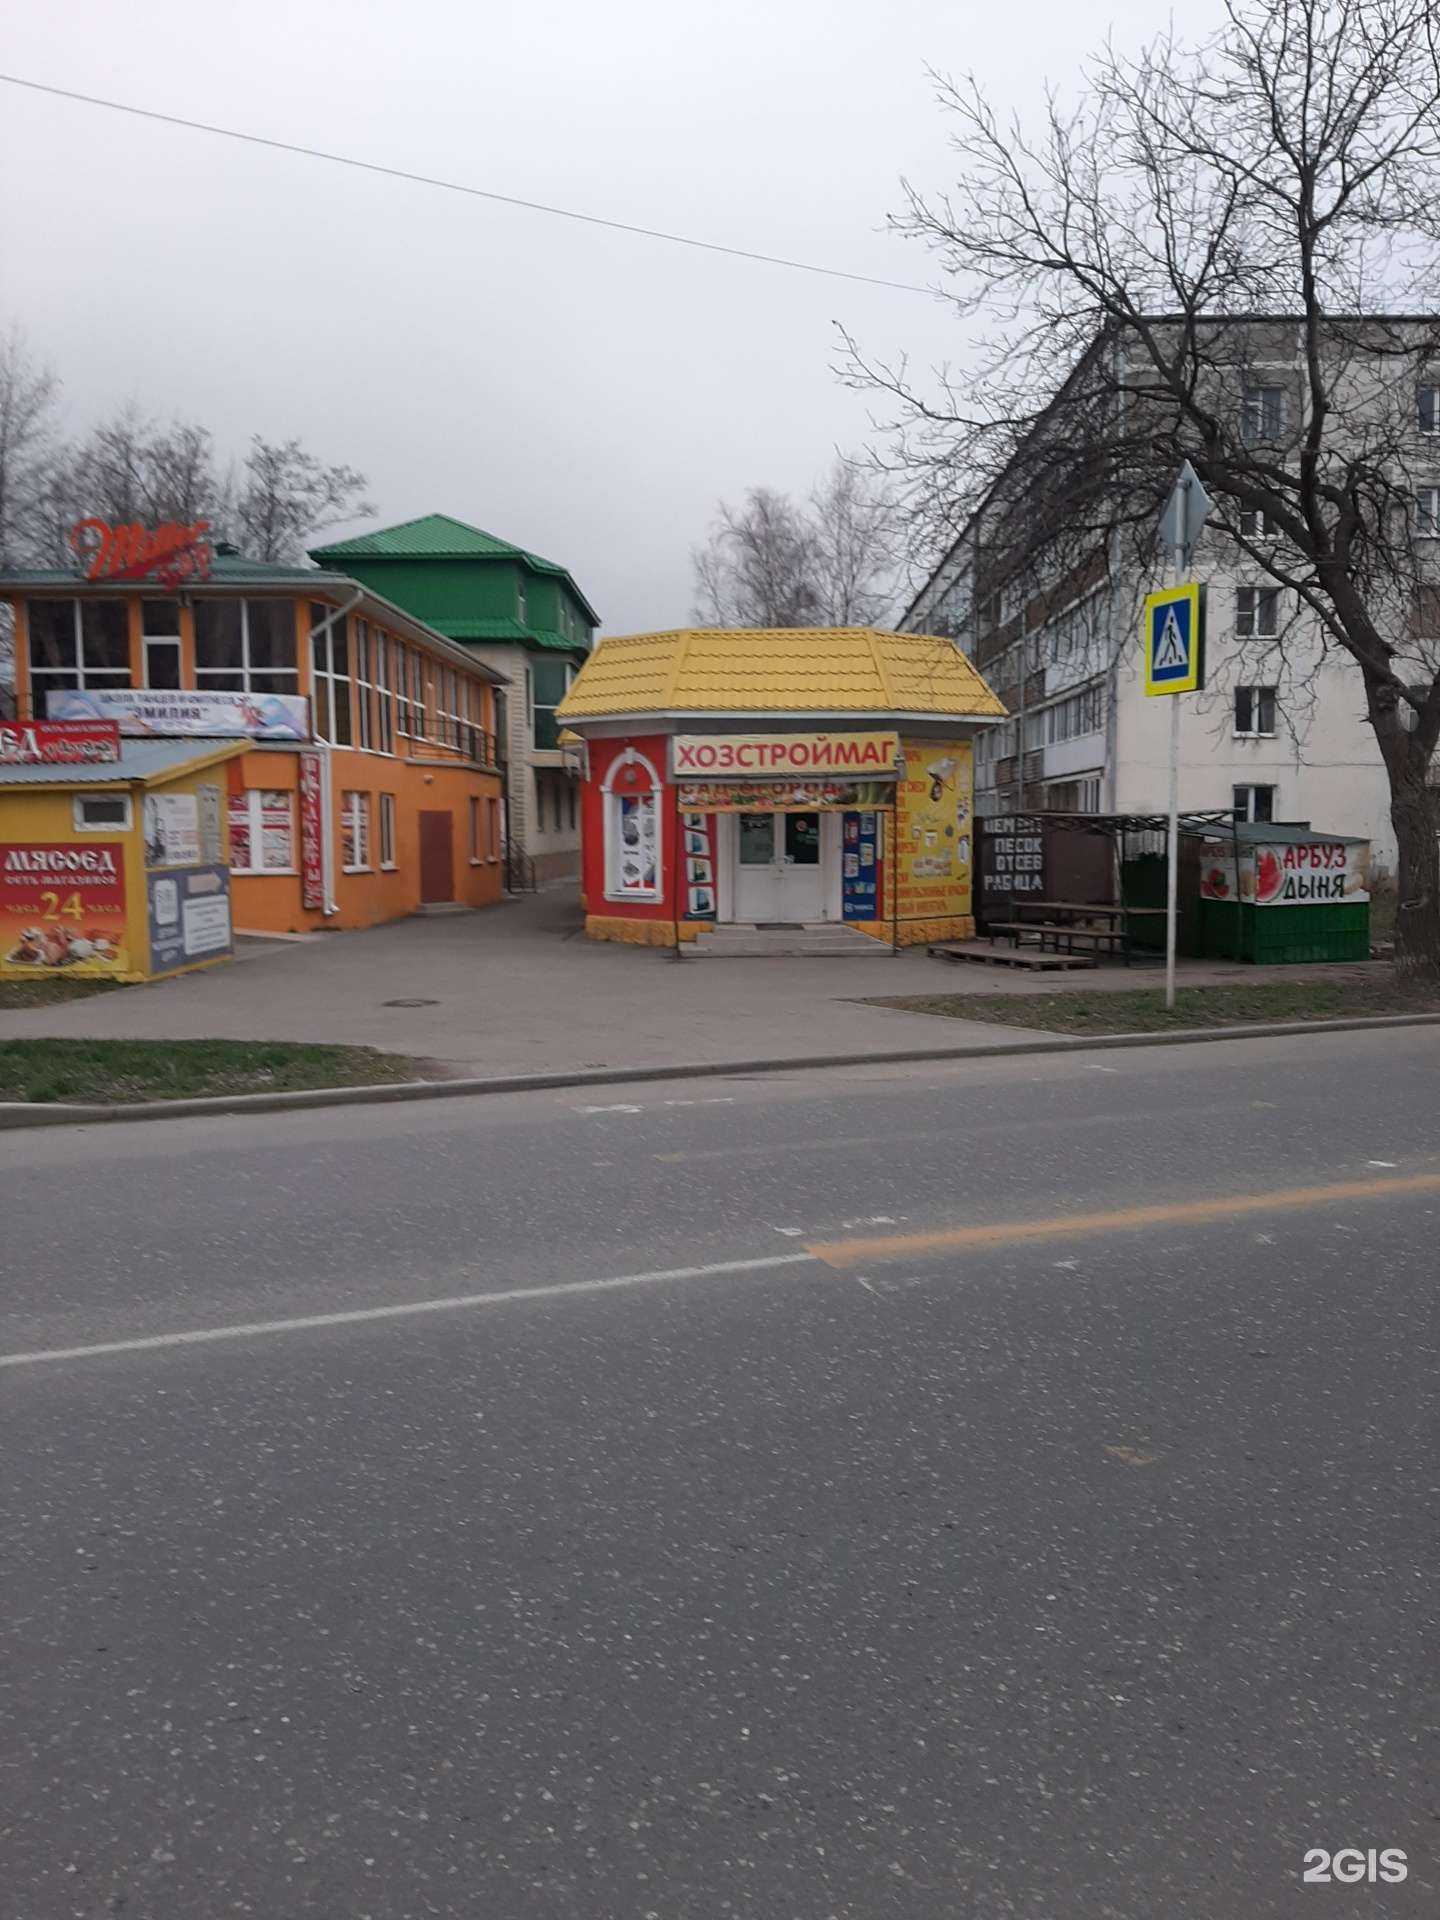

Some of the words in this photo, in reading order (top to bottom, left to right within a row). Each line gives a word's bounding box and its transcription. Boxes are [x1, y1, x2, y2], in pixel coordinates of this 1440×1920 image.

[677, 736, 895, 768] ХОЗСТРОЙМАГ
[995, 838, 1042, 853] ПЕСОК
[1283, 844, 1347, 869] АРБУЗ
[984, 874, 1043, 890] РАБИЦА
[1283, 874, 1347, 899] ДЫНЯ
[41, 891, 85, 921] 24
